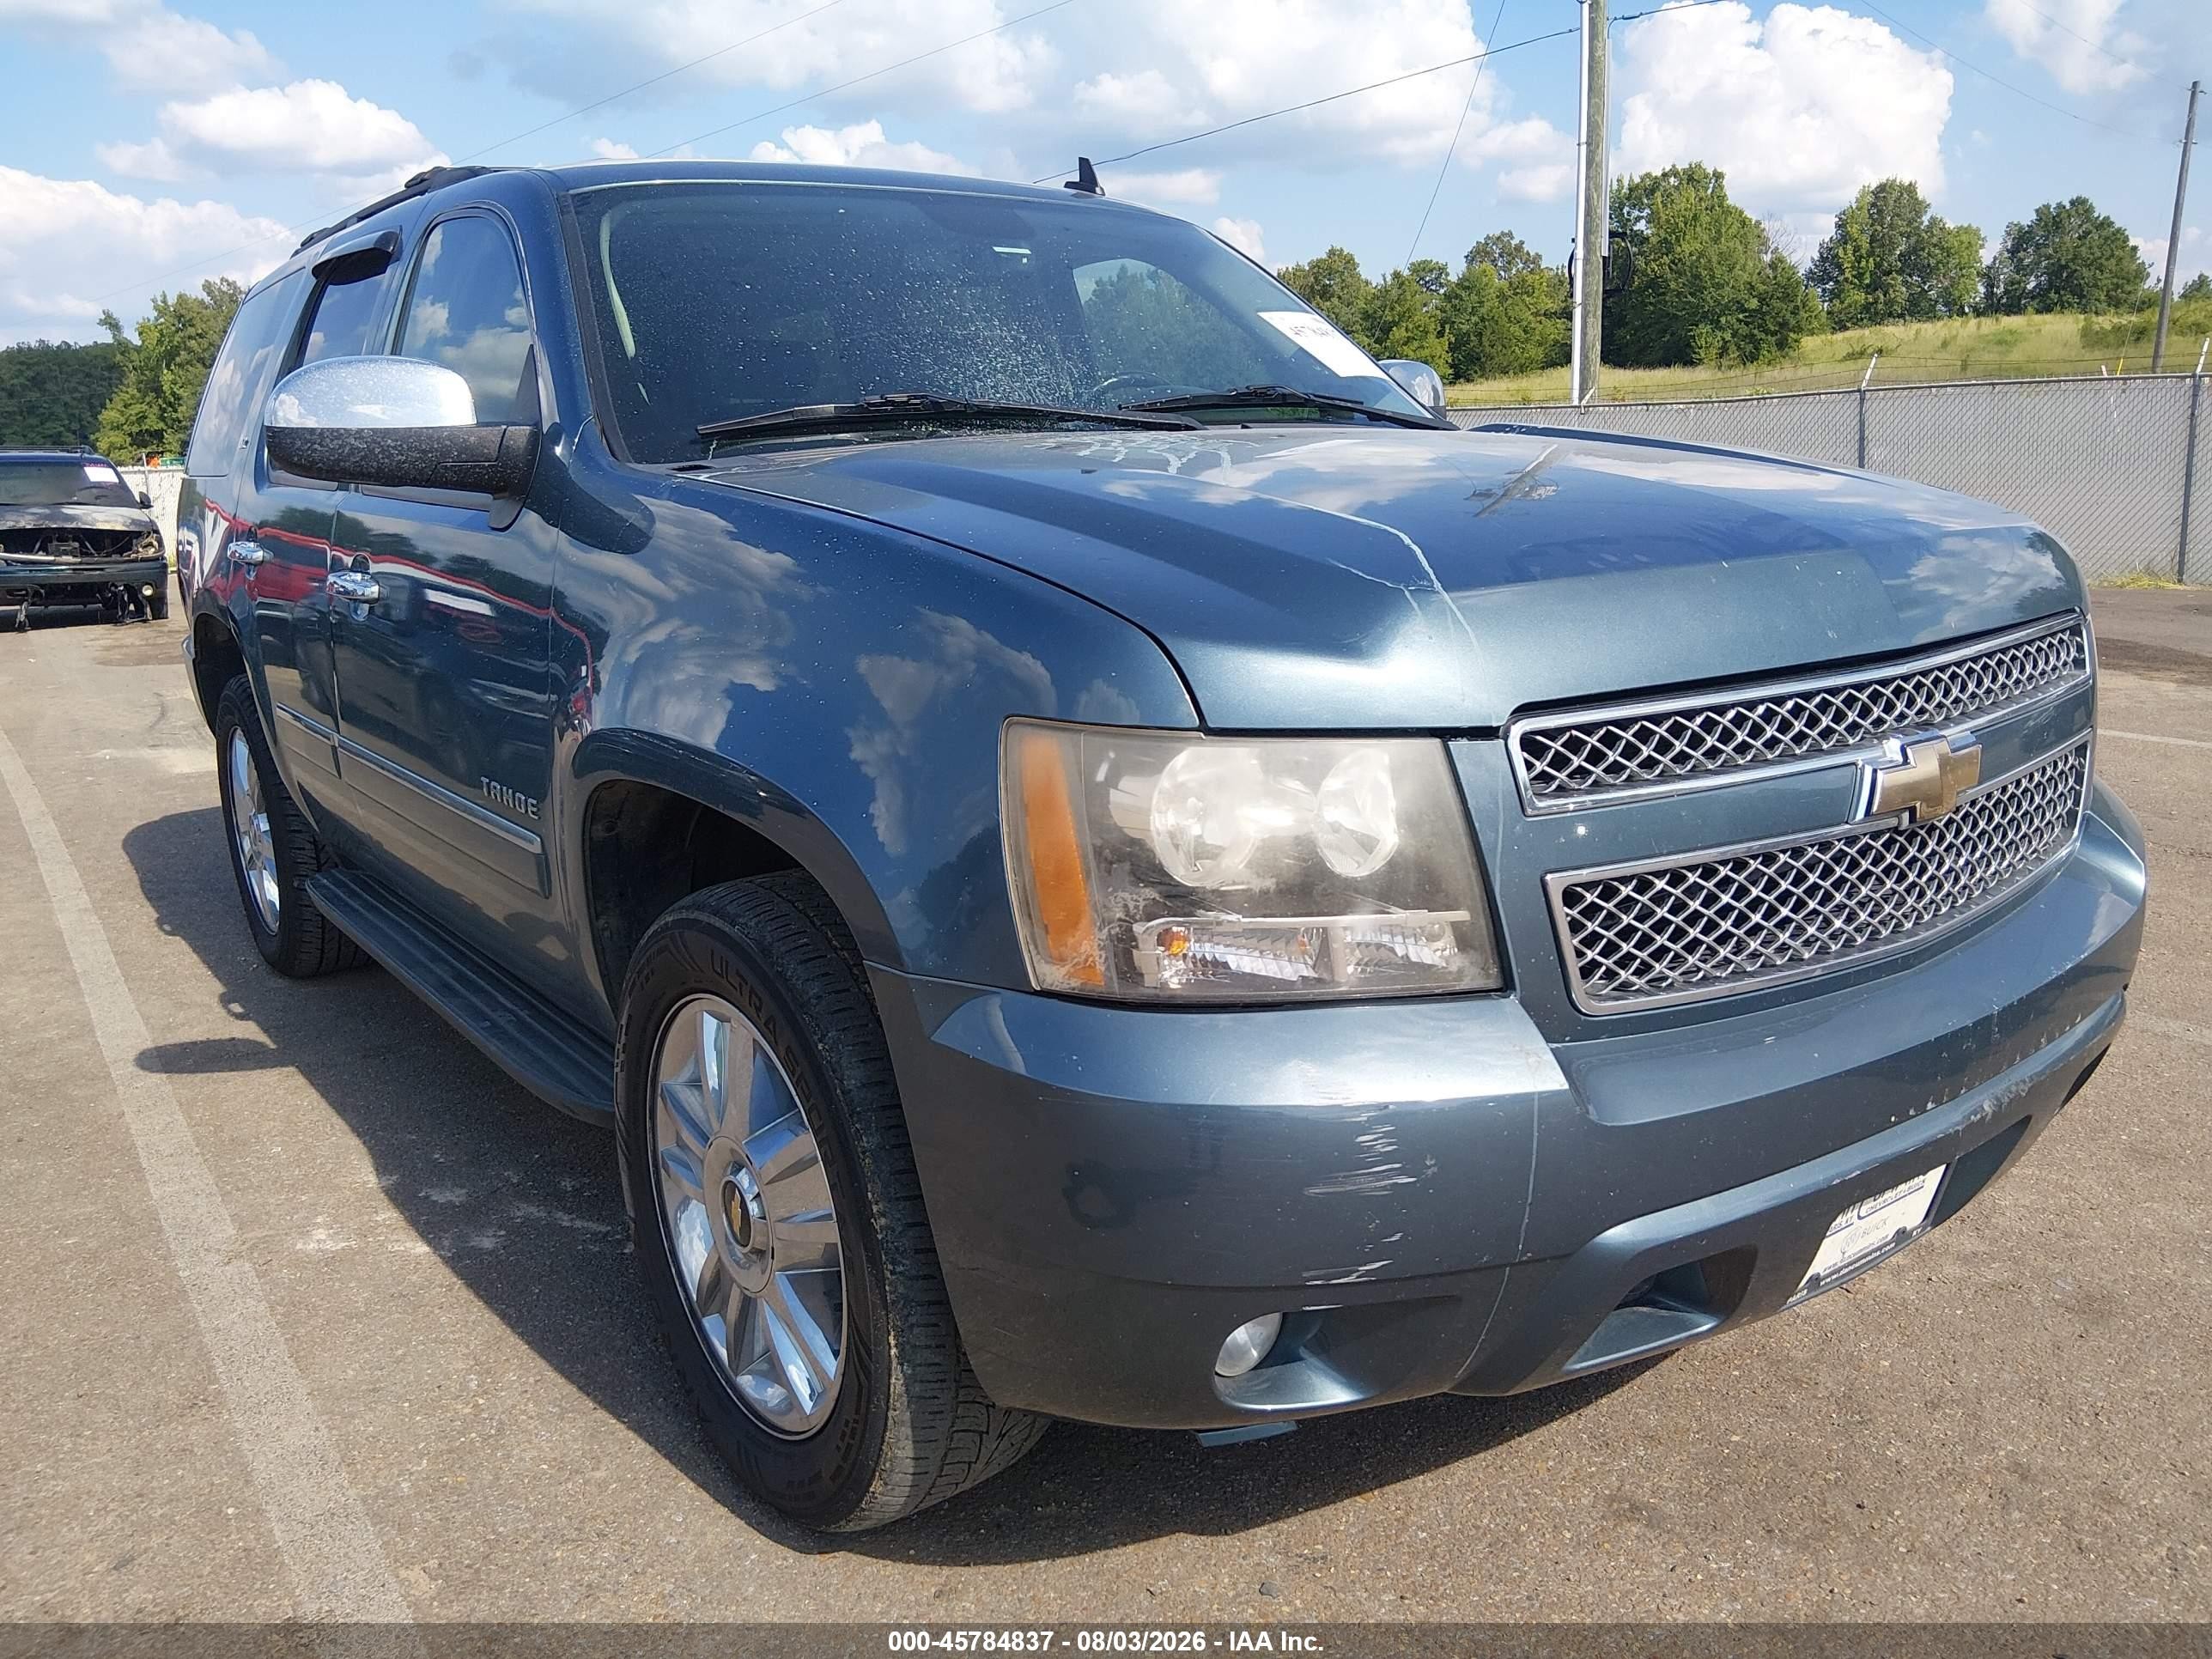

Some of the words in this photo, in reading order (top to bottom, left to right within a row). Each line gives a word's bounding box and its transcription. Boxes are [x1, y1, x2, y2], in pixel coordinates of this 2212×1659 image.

[480, 775, 541, 820] TAHOE
[709, 948, 780, 1046] ULTRA
[1860, 1215, 1890, 1239] BUICK
